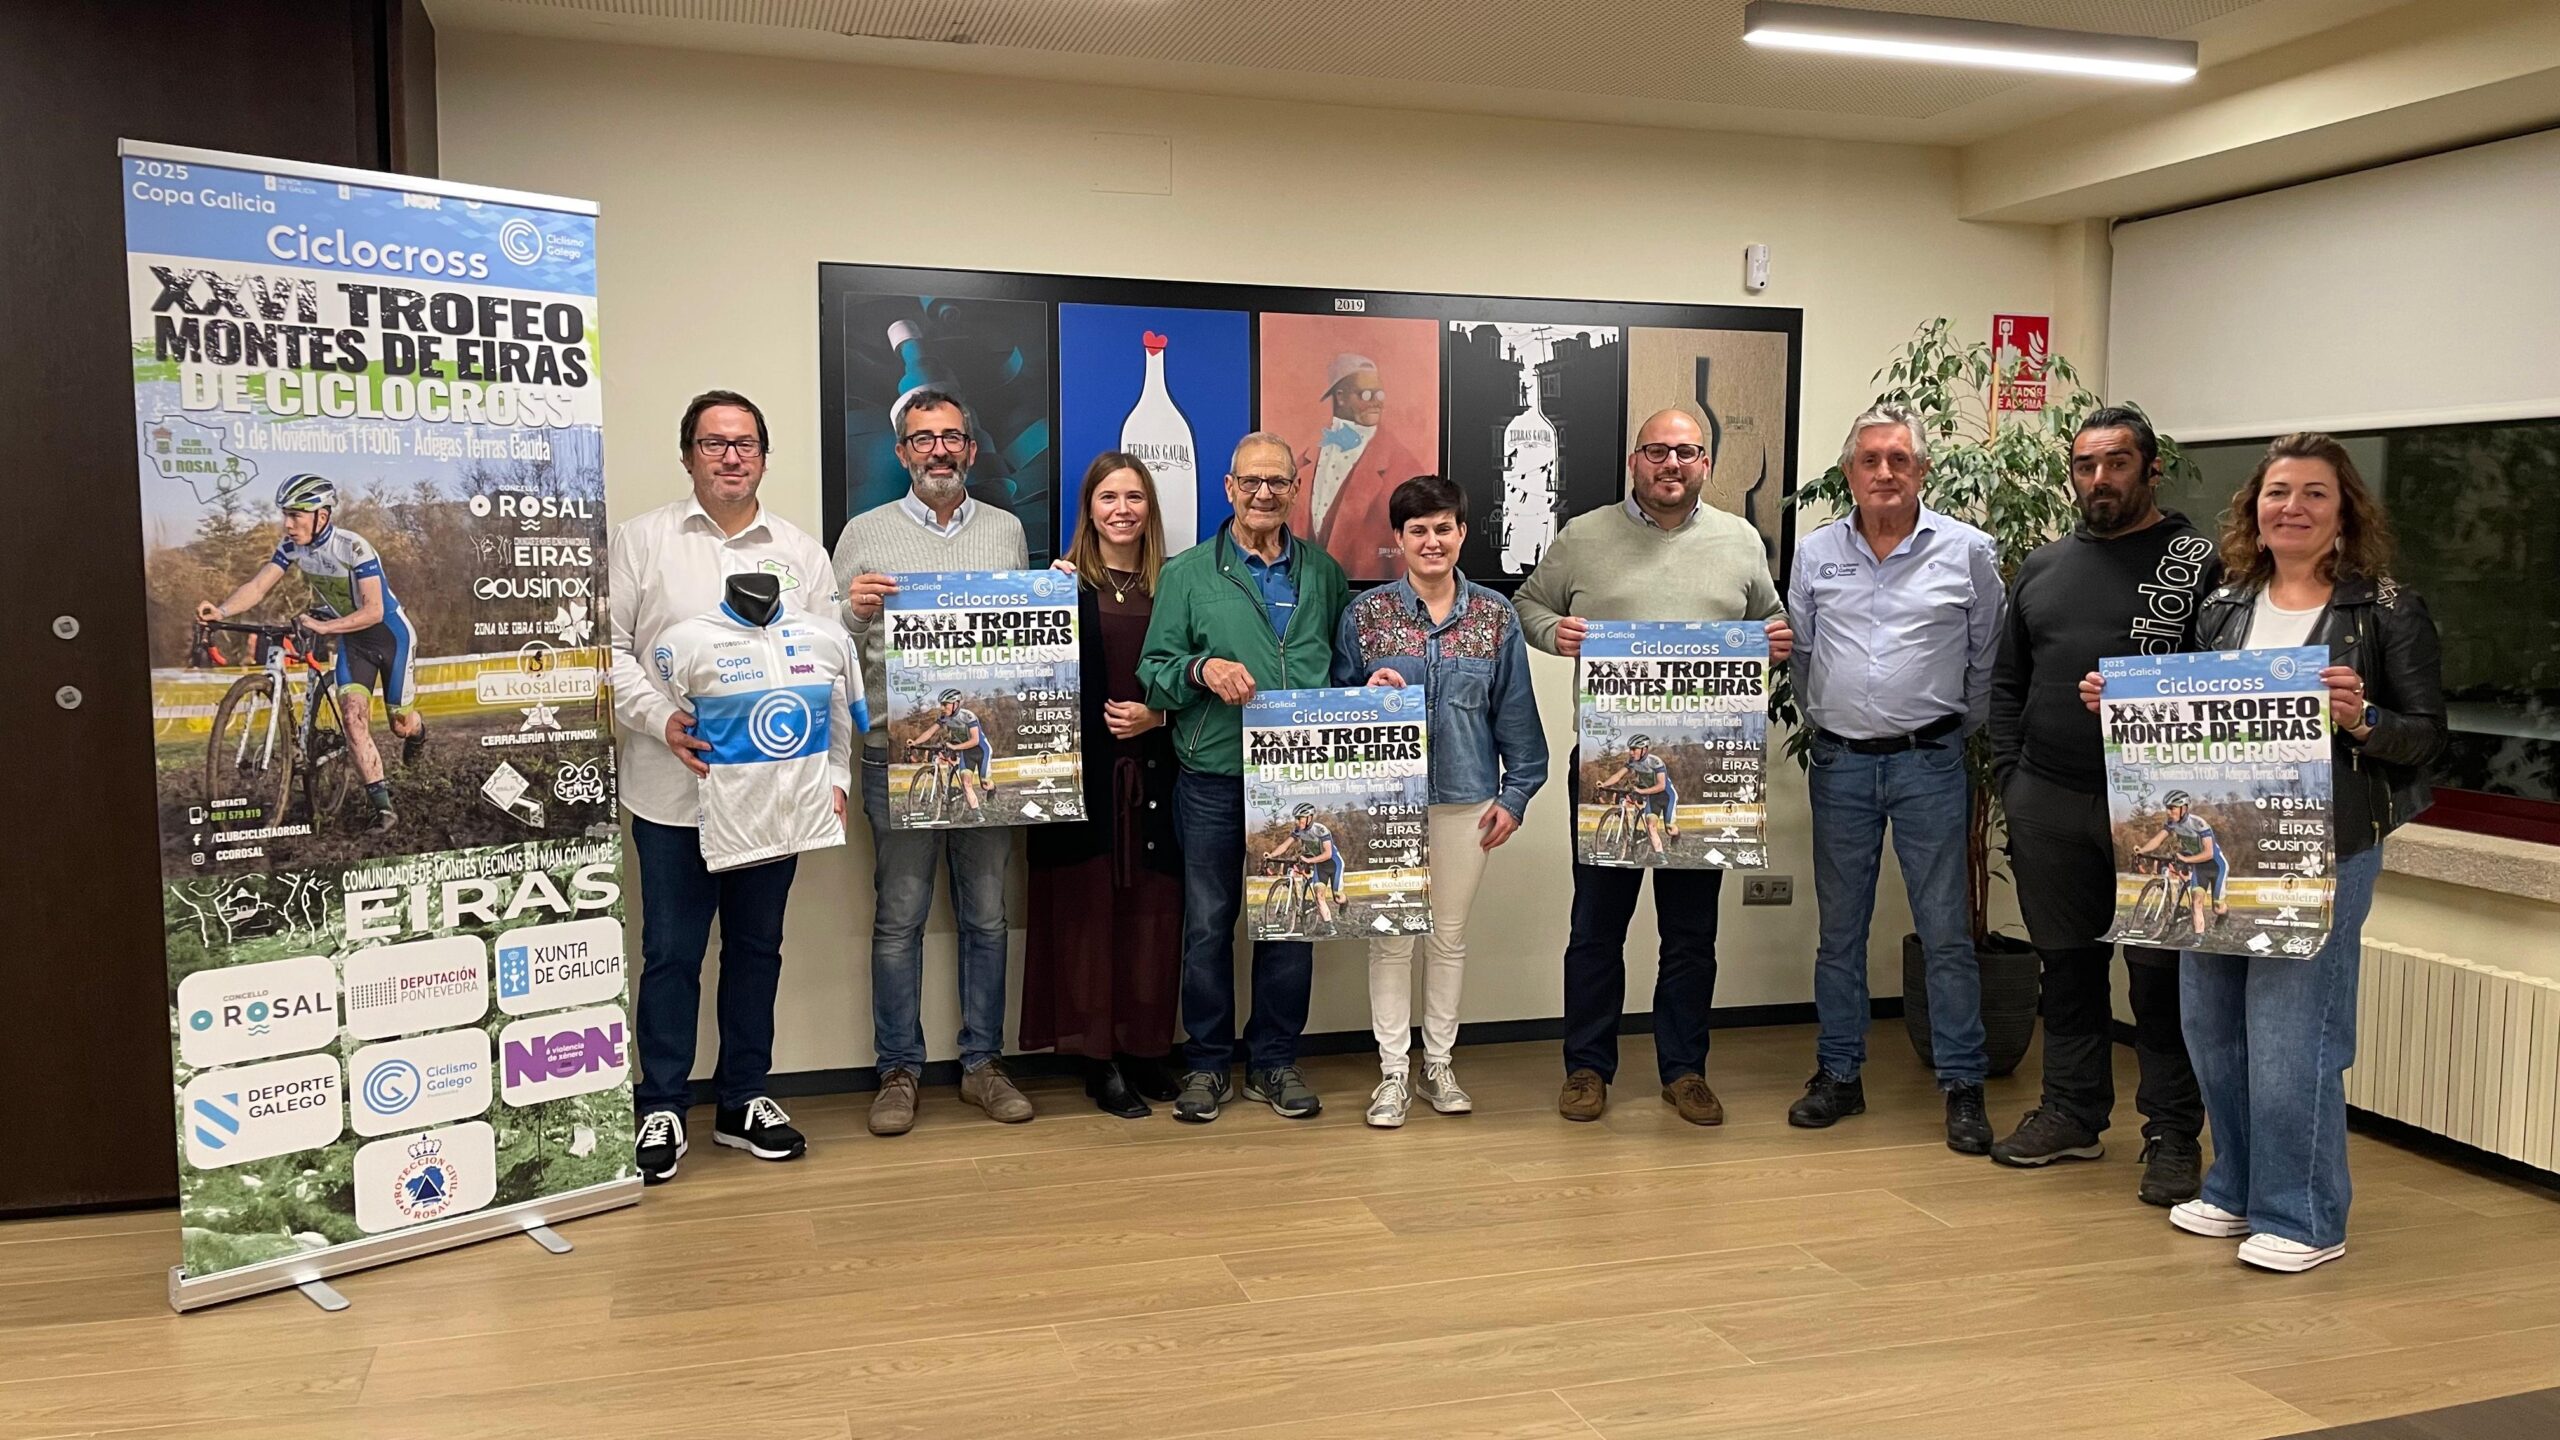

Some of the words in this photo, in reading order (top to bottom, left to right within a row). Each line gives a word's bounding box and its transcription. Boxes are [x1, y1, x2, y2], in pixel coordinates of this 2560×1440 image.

[135, 161, 188, 180] 2025
[132, 181, 194, 206] Copa
[200, 189, 276, 214] Galicia
[547, 234, 584, 248] Ciclismo
[266, 224, 489, 279] Ciclocross
[547, 245, 580, 260] Galego
[149, 265, 317, 323] XXVI
[337, 283, 584, 345] TROFEO
[1336, 300, 1363, 310] 2019
[155, 315, 368, 372] MONTES
[382, 332, 444, 378] DE
[456, 338, 587, 388] EIRAS
[181, 366, 250, 413] DE
[265, 370, 574, 428] CICLOCROSS
[234, 421, 244, 449] 9
[250, 422, 267, 450] de
[271, 422, 347, 453] Novembro
[414, 428, 462, 462] Adegas
[464, 429, 507, 459] Terras
[510, 431, 551, 461] Gauda
[1127, 443, 1160, 460] TERRAS
[1163, 444, 1189, 461] GAUDA
[162, 460, 171, 472] O
[175, 460, 219, 473] ROSAL
[499, 495, 593, 518] ROSAL
[514, 546, 593, 567] EIRAS
[893, 575, 909, 583] 025
[912, 583, 941, 591] Galicia
[937, 592, 1028, 607] Ciclocross
[2130, 536, 2213, 656] didas
[892, 613, 957, 632] XXVI
[965, 610, 1071, 631] TROFEO
[893, 631, 977, 650] MONTES
[982, 629, 1008, 647] DE
[1013, 627, 1072, 647] EIRAS
[1607, 631, 1635, 639] Galicia
[902, 650, 930, 668] DE
[935, 646, 1065, 668] CICLOCROSS
[1630, 641, 1719, 655] Ciclocross
[716, 656, 751, 668] Copa
[1587, 661, 1649, 678] XXVI
[1657, 661, 1762, 678] TROFEO
[2103, 660, 2125, 668] 2025
[720, 669, 764, 684] Galicia
[2102, 669, 2127, 678] Copa
[2129, 667, 2161, 677] Galicia
[483, 684, 498, 697] A
[506, 675, 592, 696] Rosaleira
[1587, 679, 1666, 696] MONTES
[1673, 679, 1698, 695] DE
[1703, 679, 1762, 696] EIRAS
[2156, 675, 2264, 695] Ciclocross
[1029, 690, 1072, 701] ROSAL
[1269, 700, 1296, 708] Galicia
[1595, 696, 1621, 713] DE
[1626, 696, 1753, 713] CICLOCROSS
[1035, 710, 1072, 721] EIRAS
[1292, 708, 1378, 723] Ciclocross
[2108, 701, 2180, 724] XXVI
[2188, 696, 2320, 721] TROFEO
[1250, 730, 1311, 747] XXVI
[1318, 725, 1420, 745] TROFEO
[2111, 722, 2204, 745] MONTES
[2210, 721, 2241, 742] DE
[2248, 719, 2322, 742] EIRAS
[1251, 746, 1328, 765] MONTES
[1334, 745, 1359, 762] DE
[1364, 743, 1421, 761] EIRAS
[1717, 741, 1760, 751] ROSAL
[2122, 743, 2151, 765] DE
[2156, 742, 2312, 764] CICLOCROSS
[1260, 766, 1285, 783] DE
[1290, 762, 1414, 782] CICLOCROSS
[1722, 761, 1759, 771] EIRAS
[1380, 805, 1422, 815] ROSAL
[2271, 797, 2324, 810] ROSAL
[1386, 825, 1421, 835] EIRAS
[2279, 824, 2324, 835] EIRAS
[342, 864, 416, 891] COMUNIDADE
[418, 862, 433, 882] DE
[435, 858, 477, 881] MONTES
[525, 850, 539, 870] EN
[540, 848, 562, 869] MAN
[564, 841, 599, 865] COMÚN
[599, 842, 613, 861] DE
[344, 864, 620, 941] EIRAS
[535, 941, 588, 965] XUNTA
[400, 966, 477, 990] DEPUTACIÓN
[535, 968, 555, 985] DE
[559, 956, 620, 982] GALICIA
[223, 990, 269, 1002] CONCELLO
[401, 980, 479, 1002] PONTEVEDRA
[223, 992, 332, 1028] ROSAL
[505, 1022, 623, 1089] NON
[552, 1042, 585, 1054] violencia
[558, 1050, 584, 1060] xénero
[426, 1062, 477, 1077] Ciclismo
[248, 1076, 335, 1102] DEPORTE
[427, 1076, 472, 1091] Galego
[249, 1093, 326, 1118] GALEGO
[445, 1164, 458, 1190] CIVIL
[414, 1200, 451, 1219] ROSAL
